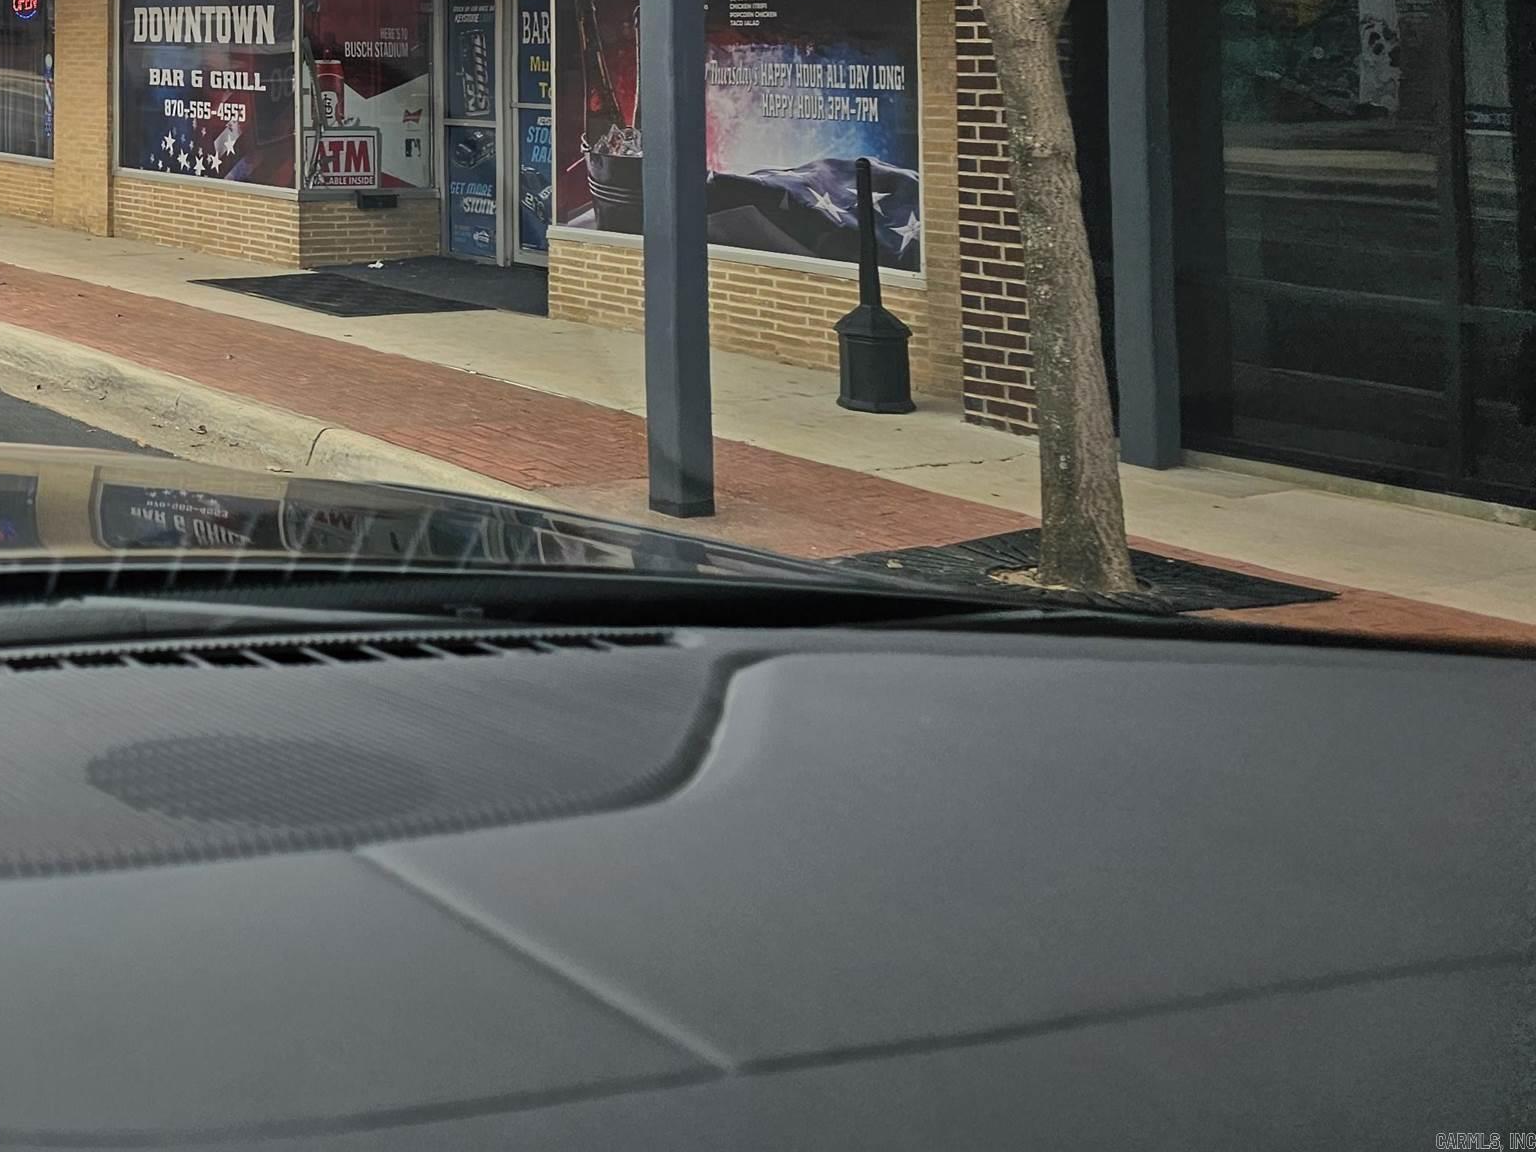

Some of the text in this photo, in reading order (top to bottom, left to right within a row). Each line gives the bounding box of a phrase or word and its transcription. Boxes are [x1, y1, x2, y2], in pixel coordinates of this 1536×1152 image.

[133, 5, 276, 45] DOWNTOWN
[344, 41, 409, 58] BUSCH STADIUM
[149, 68, 267, 91] BAR & GRILL
[761, 63, 793, 87] HAPPY
[795, 64, 824, 88] HOUR
[826, 64, 847, 89] ALL
[849, 64, 871, 89] DAY
[873, 65, 905, 91] LONG!
[164, 99, 246, 123] 870-565-4553
[762, 93, 879, 122] HAPPY HOUR 3PM-7PM
[317, 140, 371, 173] ATM
[349, 176, 374, 185] INSIDE
[451, 182, 465, 194] GET
